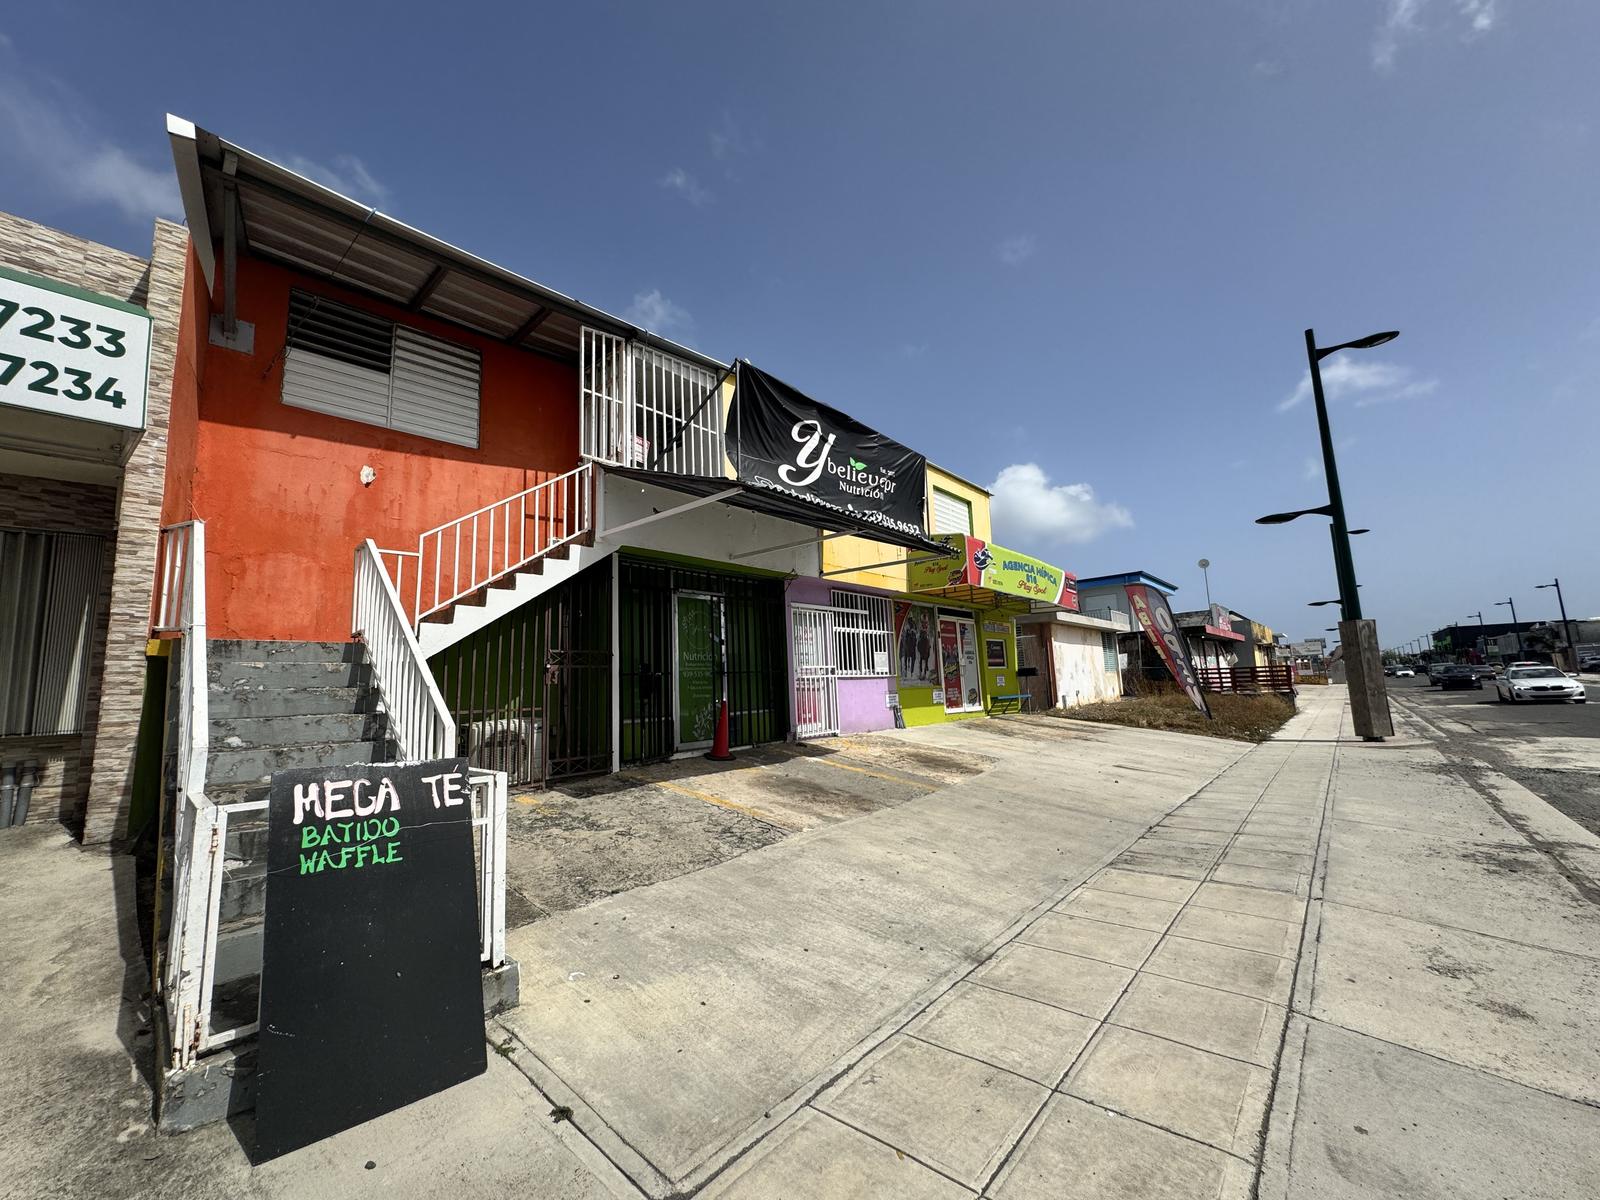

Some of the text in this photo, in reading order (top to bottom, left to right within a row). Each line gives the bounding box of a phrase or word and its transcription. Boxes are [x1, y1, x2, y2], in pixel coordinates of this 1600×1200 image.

[0, 353, 127, 409] 7234
[1003, 560, 1035, 574] AGENCIA
[293, 764, 464, 824] MEGA TÉ
[301, 817, 400, 849] BATIDO
[300, 842, 403, 875] WAFFLE
